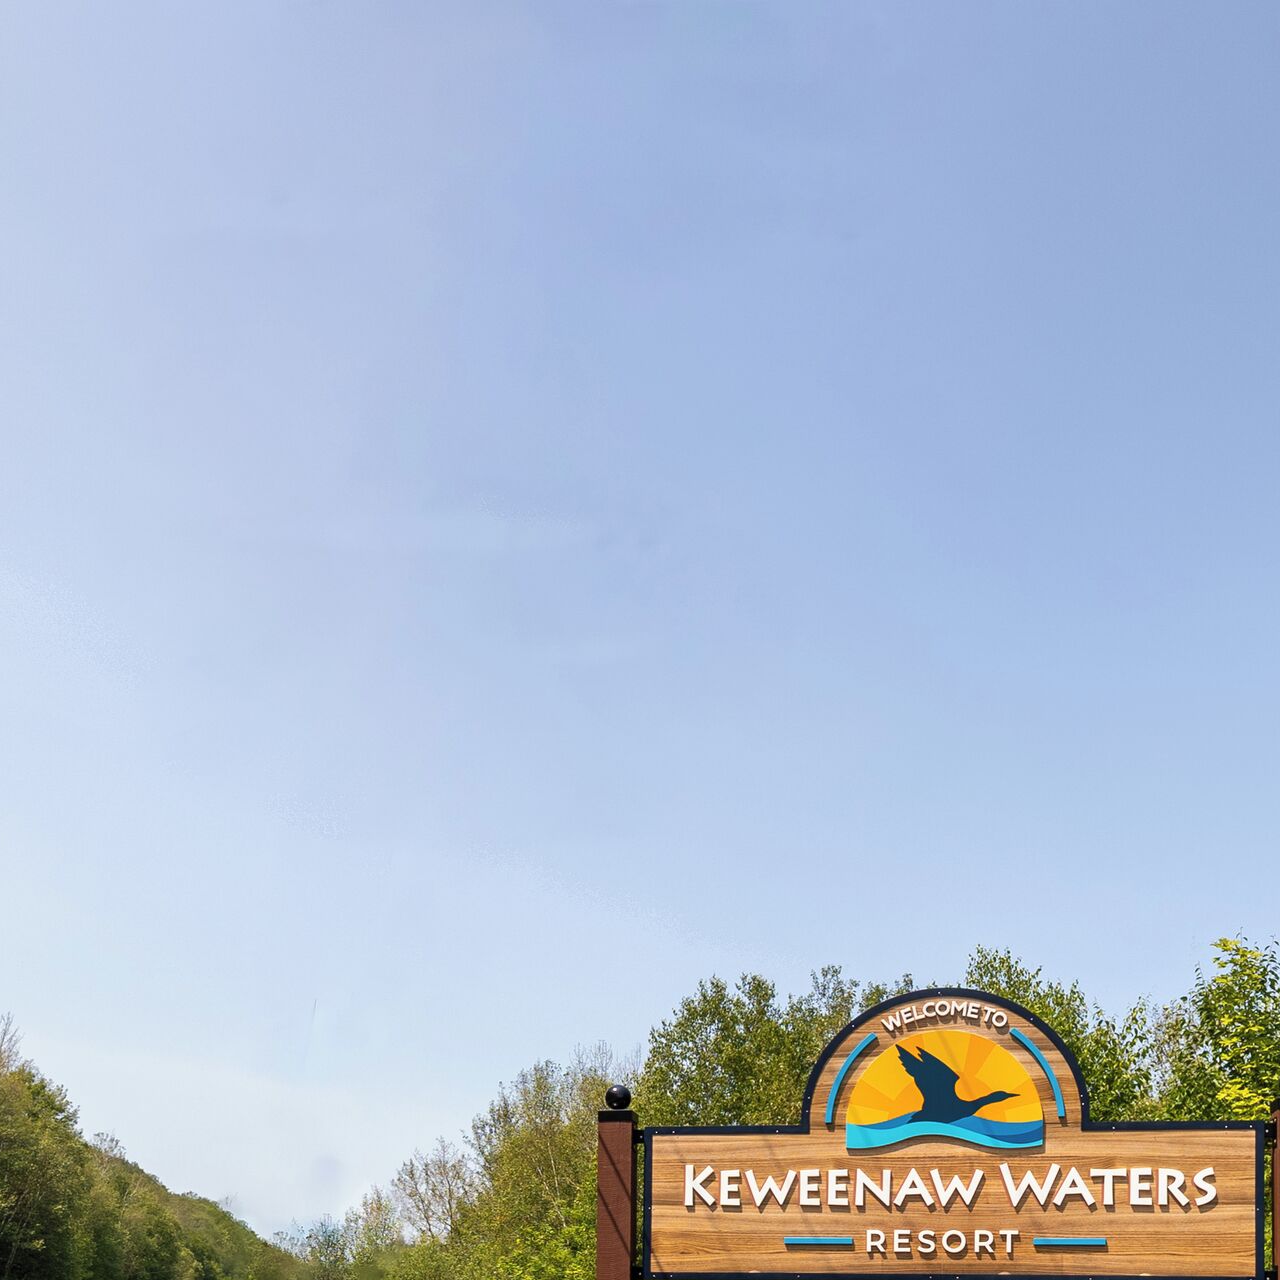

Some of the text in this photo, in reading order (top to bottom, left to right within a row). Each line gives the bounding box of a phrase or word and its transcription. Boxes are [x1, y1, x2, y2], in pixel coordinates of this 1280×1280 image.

[880, 1001, 1008, 1032] WELCOME TO
[684, 1162, 1218, 1208] KEWEENAW WATERS
[865, 1229, 1019, 1254] RESORT
